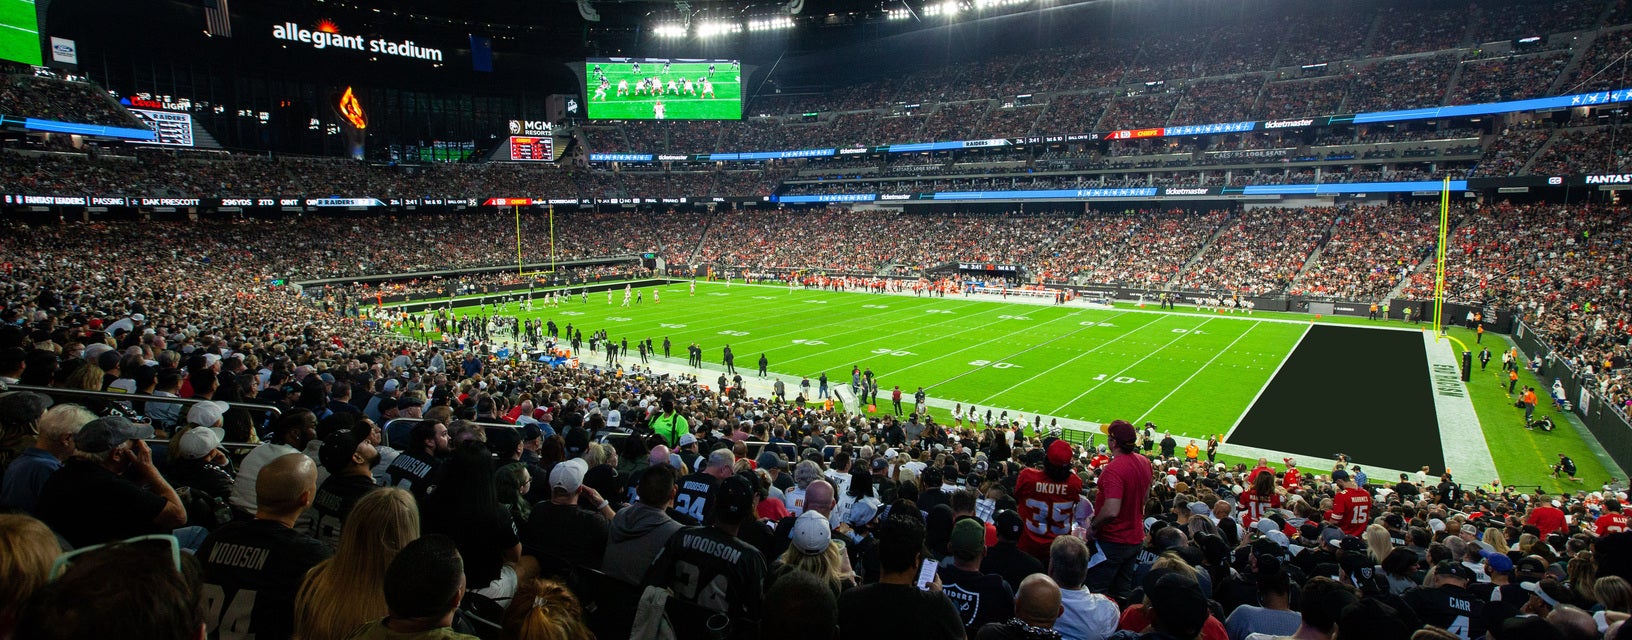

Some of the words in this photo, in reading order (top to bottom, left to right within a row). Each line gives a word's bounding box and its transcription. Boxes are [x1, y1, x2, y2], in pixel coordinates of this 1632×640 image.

[273, 22, 364, 49] allegiant
[370, 38, 442, 61] stadium
[162, 101, 190, 111] LIGHT
[152, 113, 187, 121] RAIDERS
[1265, 119, 1313, 128] ticketmaster
[525, 121, 552, 131] MGM
[1585, 173, 1632, 184] FANTAS
[25, 195, 54, 204] FANTASY
[55, 197, 85, 205] LEADERS
[92, 198, 124, 206] PASSING
[142, 198, 160, 206] DAK
[161, 198, 200, 206] PRESCOTT
[1092, 374, 1137, 384] 10
[683, 480, 710, 493] WOODSON
[1036, 481, 1068, 495] OKOYE
[674, 492, 706, 522] 24
[1026, 498, 1074, 535] 35
[1351, 505, 1369, 524] 15
[208, 541, 270, 571] WOODSON
[683, 534, 742, 565] WOODSON
[942, 588, 973, 601] AIDERS
[1449, 596, 1471, 612] CARR
[1447, 615, 1471, 640] 4
